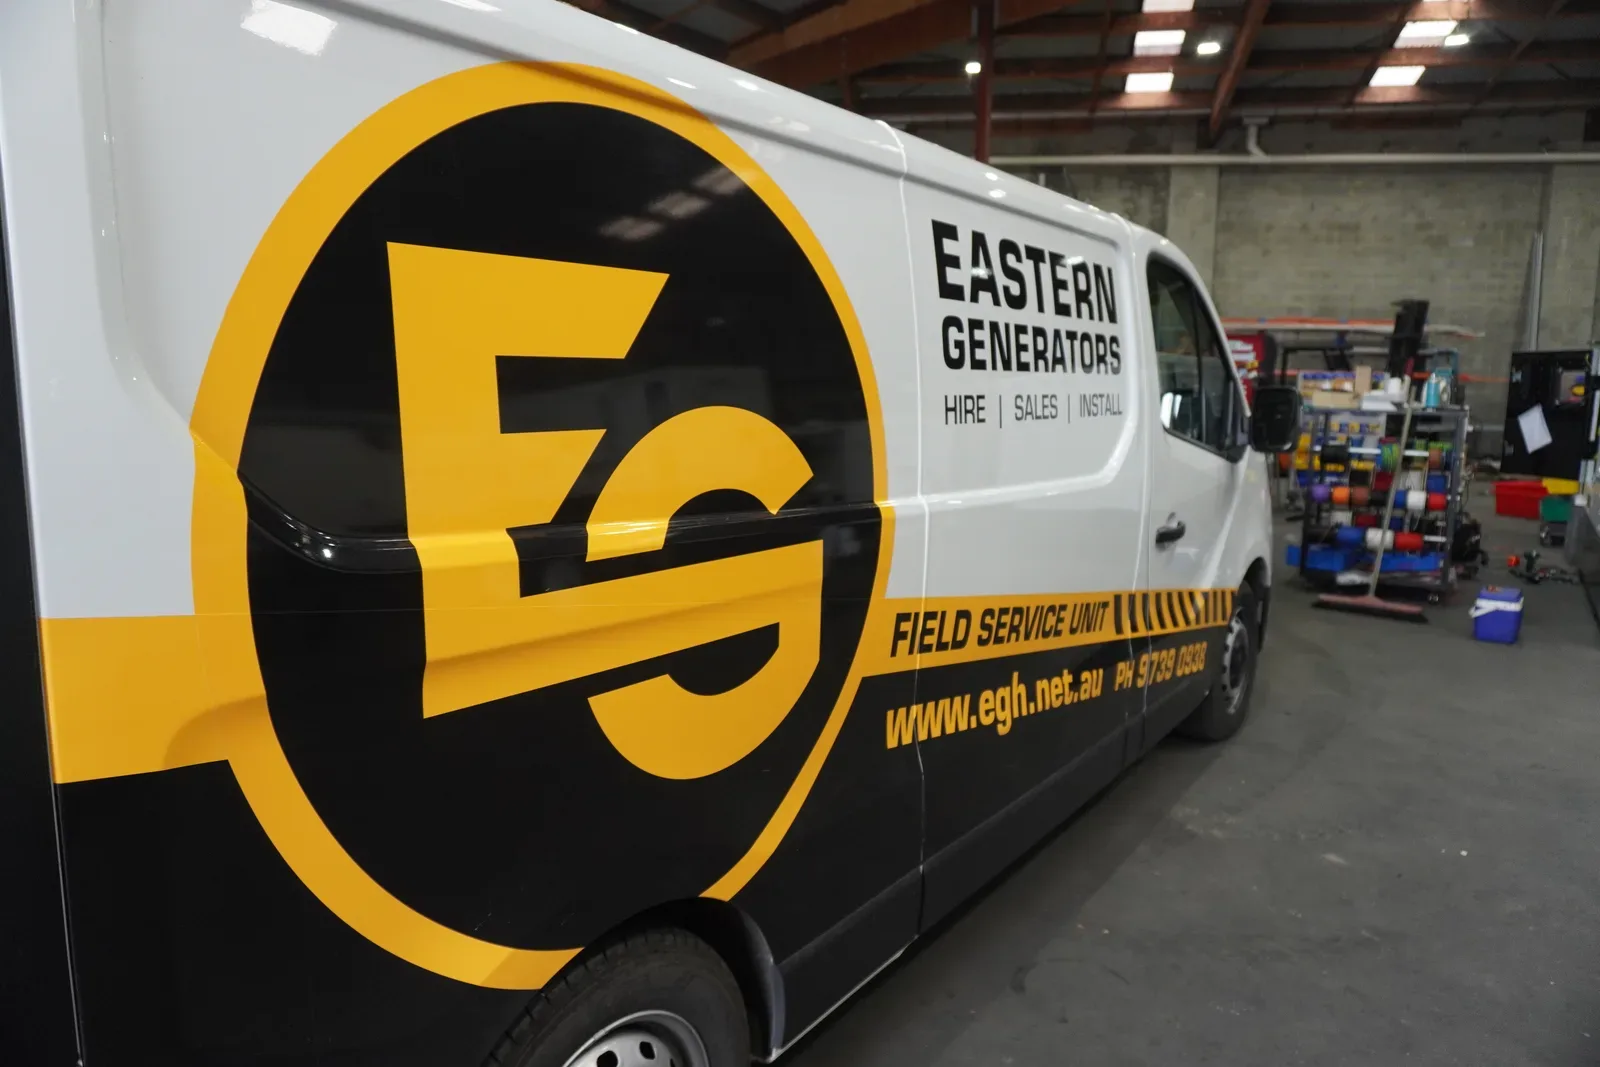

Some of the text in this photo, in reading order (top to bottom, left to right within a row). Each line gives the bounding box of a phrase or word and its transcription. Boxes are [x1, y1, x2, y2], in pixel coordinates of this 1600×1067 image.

[931, 219, 1118, 324] EASTERN
[941, 315, 1121, 375] GENERATORS
[944, 393, 1123, 425] HIRE SALES INSTALL
[890, 601, 1110, 658] FIELD SERVICE UNIT
[886, 668, 1104, 750] www.egh.net.au
[1114, 660, 1135, 692] PH
[1136, 648, 1176, 688] 9739
